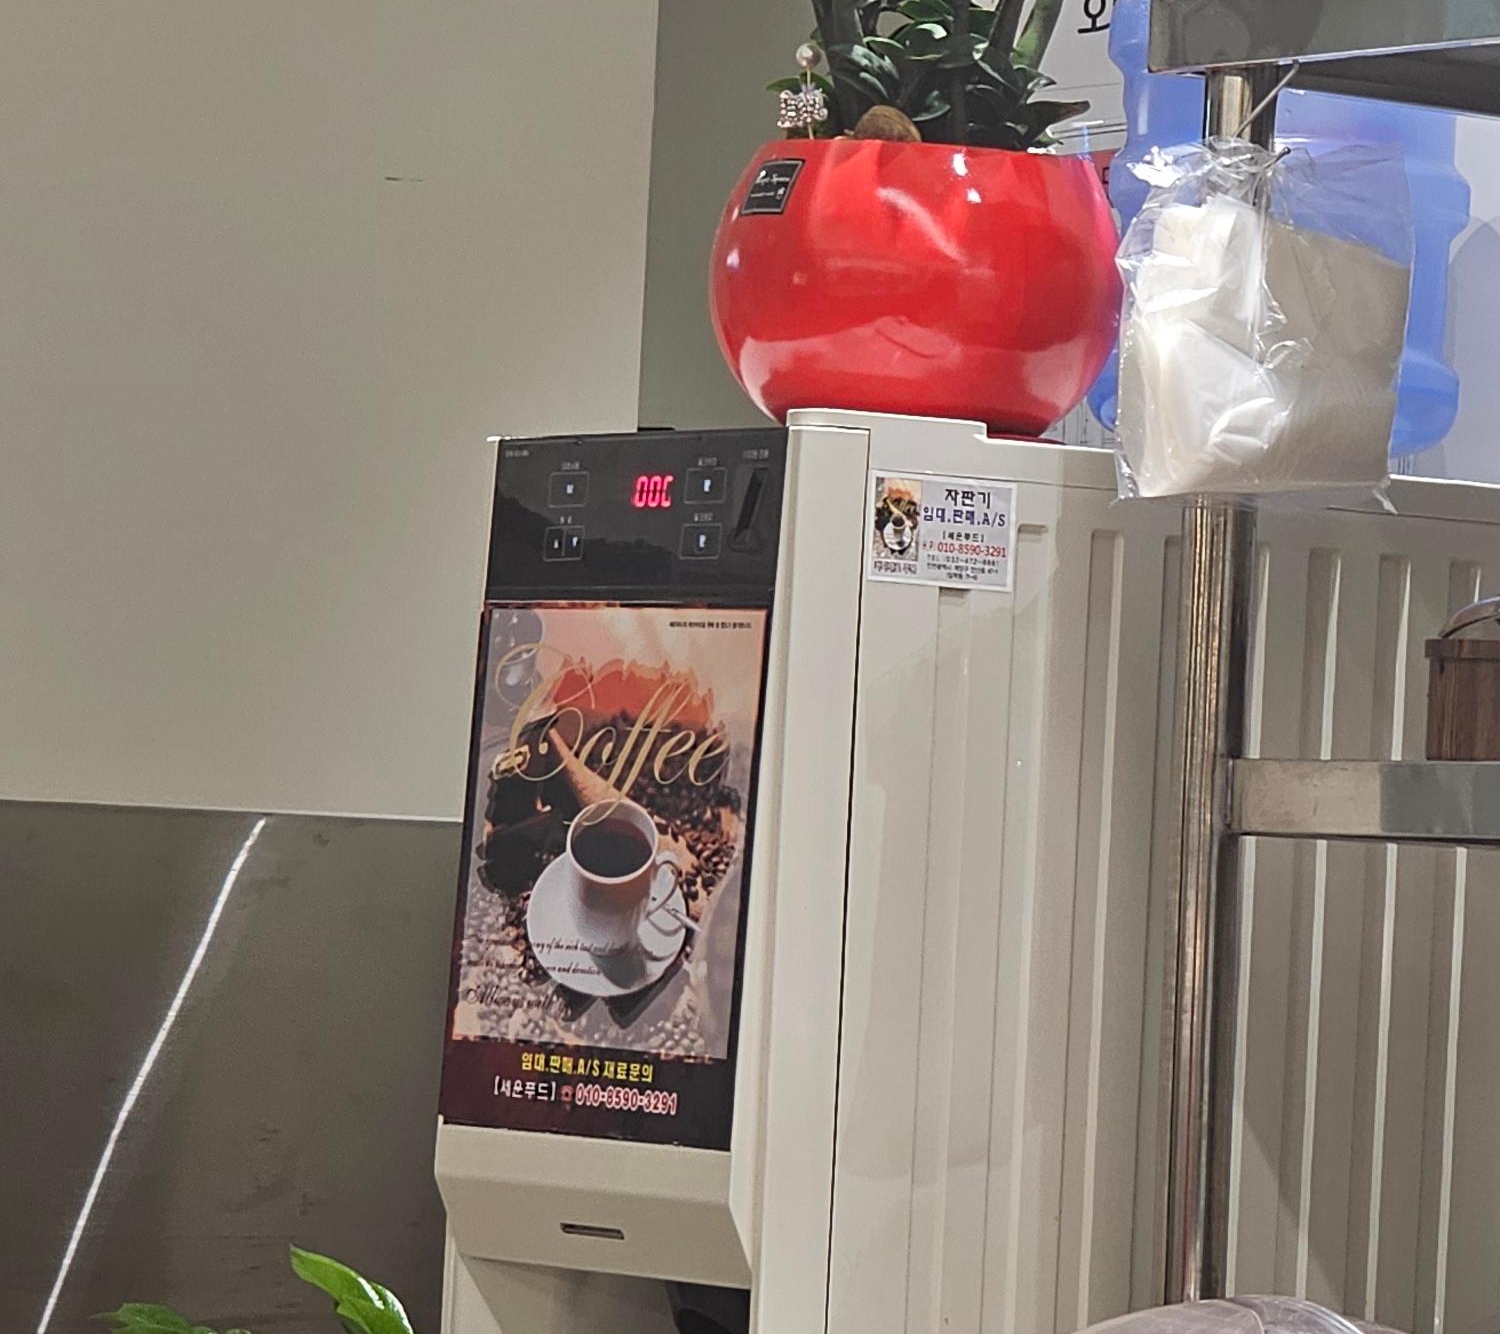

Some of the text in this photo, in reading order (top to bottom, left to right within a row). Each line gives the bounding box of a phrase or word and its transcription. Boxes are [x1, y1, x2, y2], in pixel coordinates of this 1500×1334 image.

[945, 488, 991, 509] 자판기
[496, 643, 730, 827] Coffee
[603, 1060, 654, 1083] 재료문의
[575, 1083, 678, 1116] 010-8590-3291
